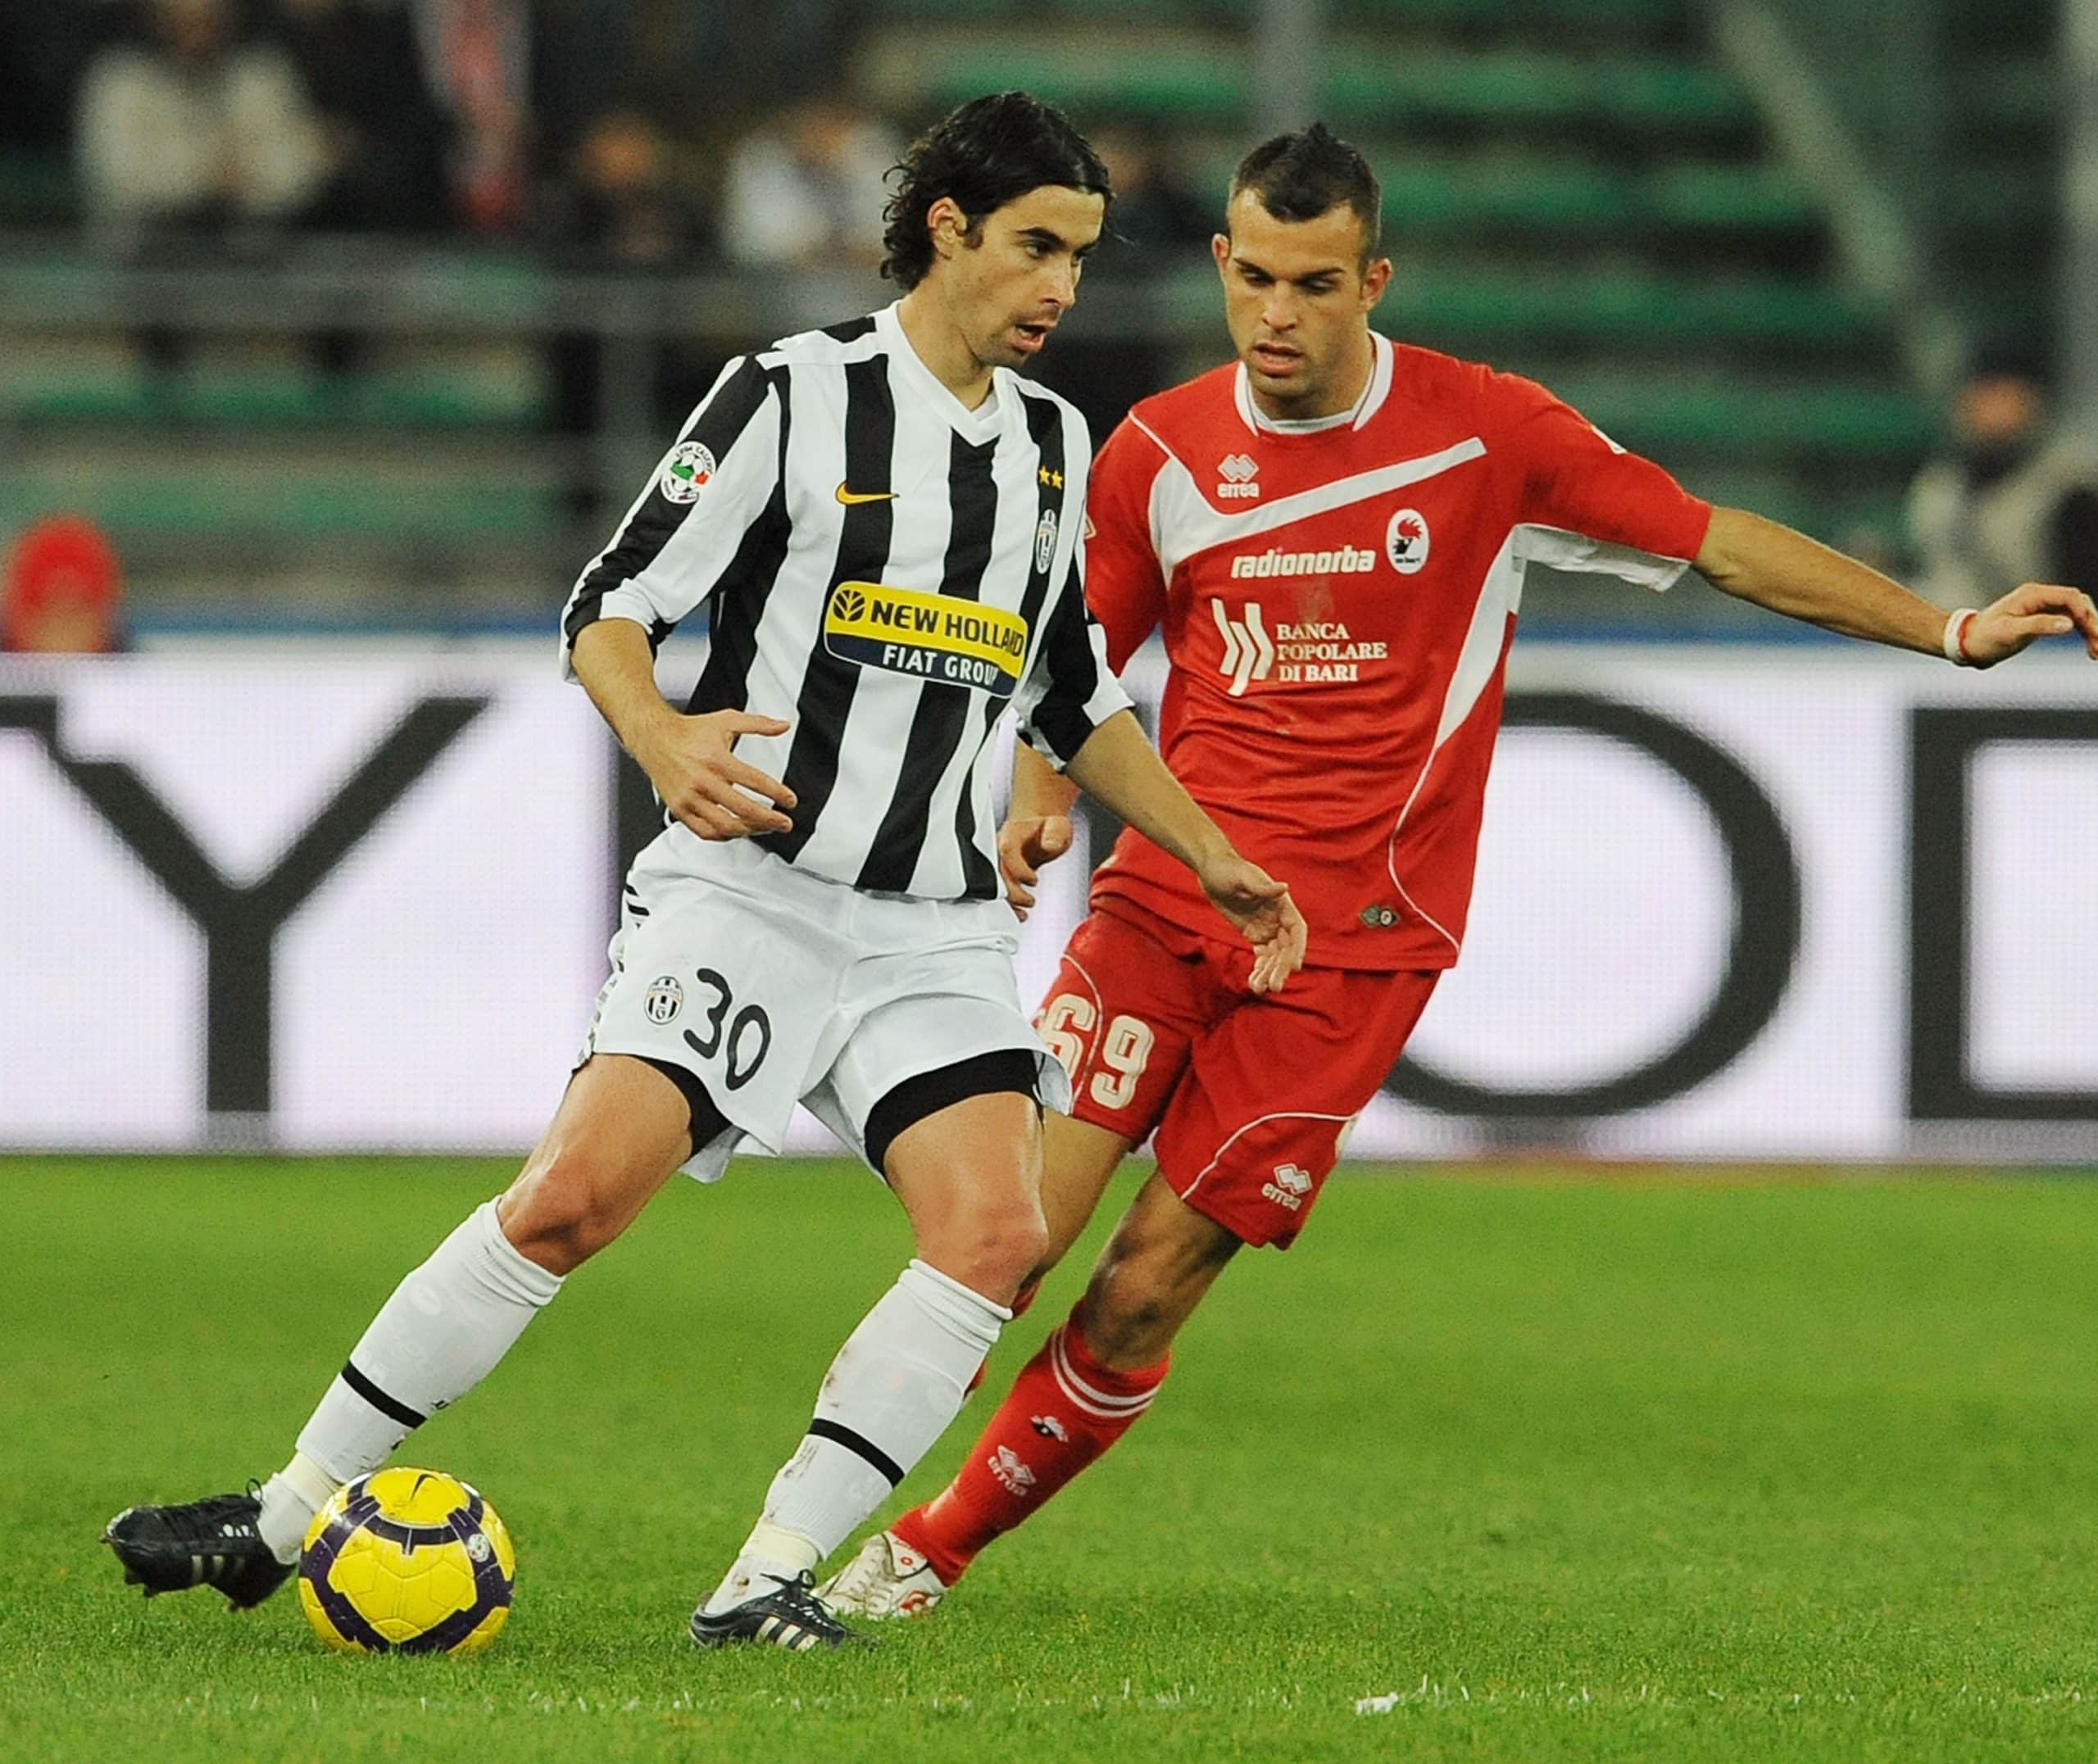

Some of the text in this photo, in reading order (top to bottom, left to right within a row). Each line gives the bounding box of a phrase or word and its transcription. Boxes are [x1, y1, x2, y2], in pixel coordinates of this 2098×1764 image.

[1231, 545, 1377, 578] radionorba
[870, 600, 939, 633] NEW
[1277, 623, 1350, 641] BANCA
[883, 645, 938, 673] FIAT
[1277, 642, 1387, 661] POPOLARE
[1278, 664, 1358, 682] DI BARI
[683, 968, 771, 1091] 30
[1030, 992, 1155, 1109] 69
